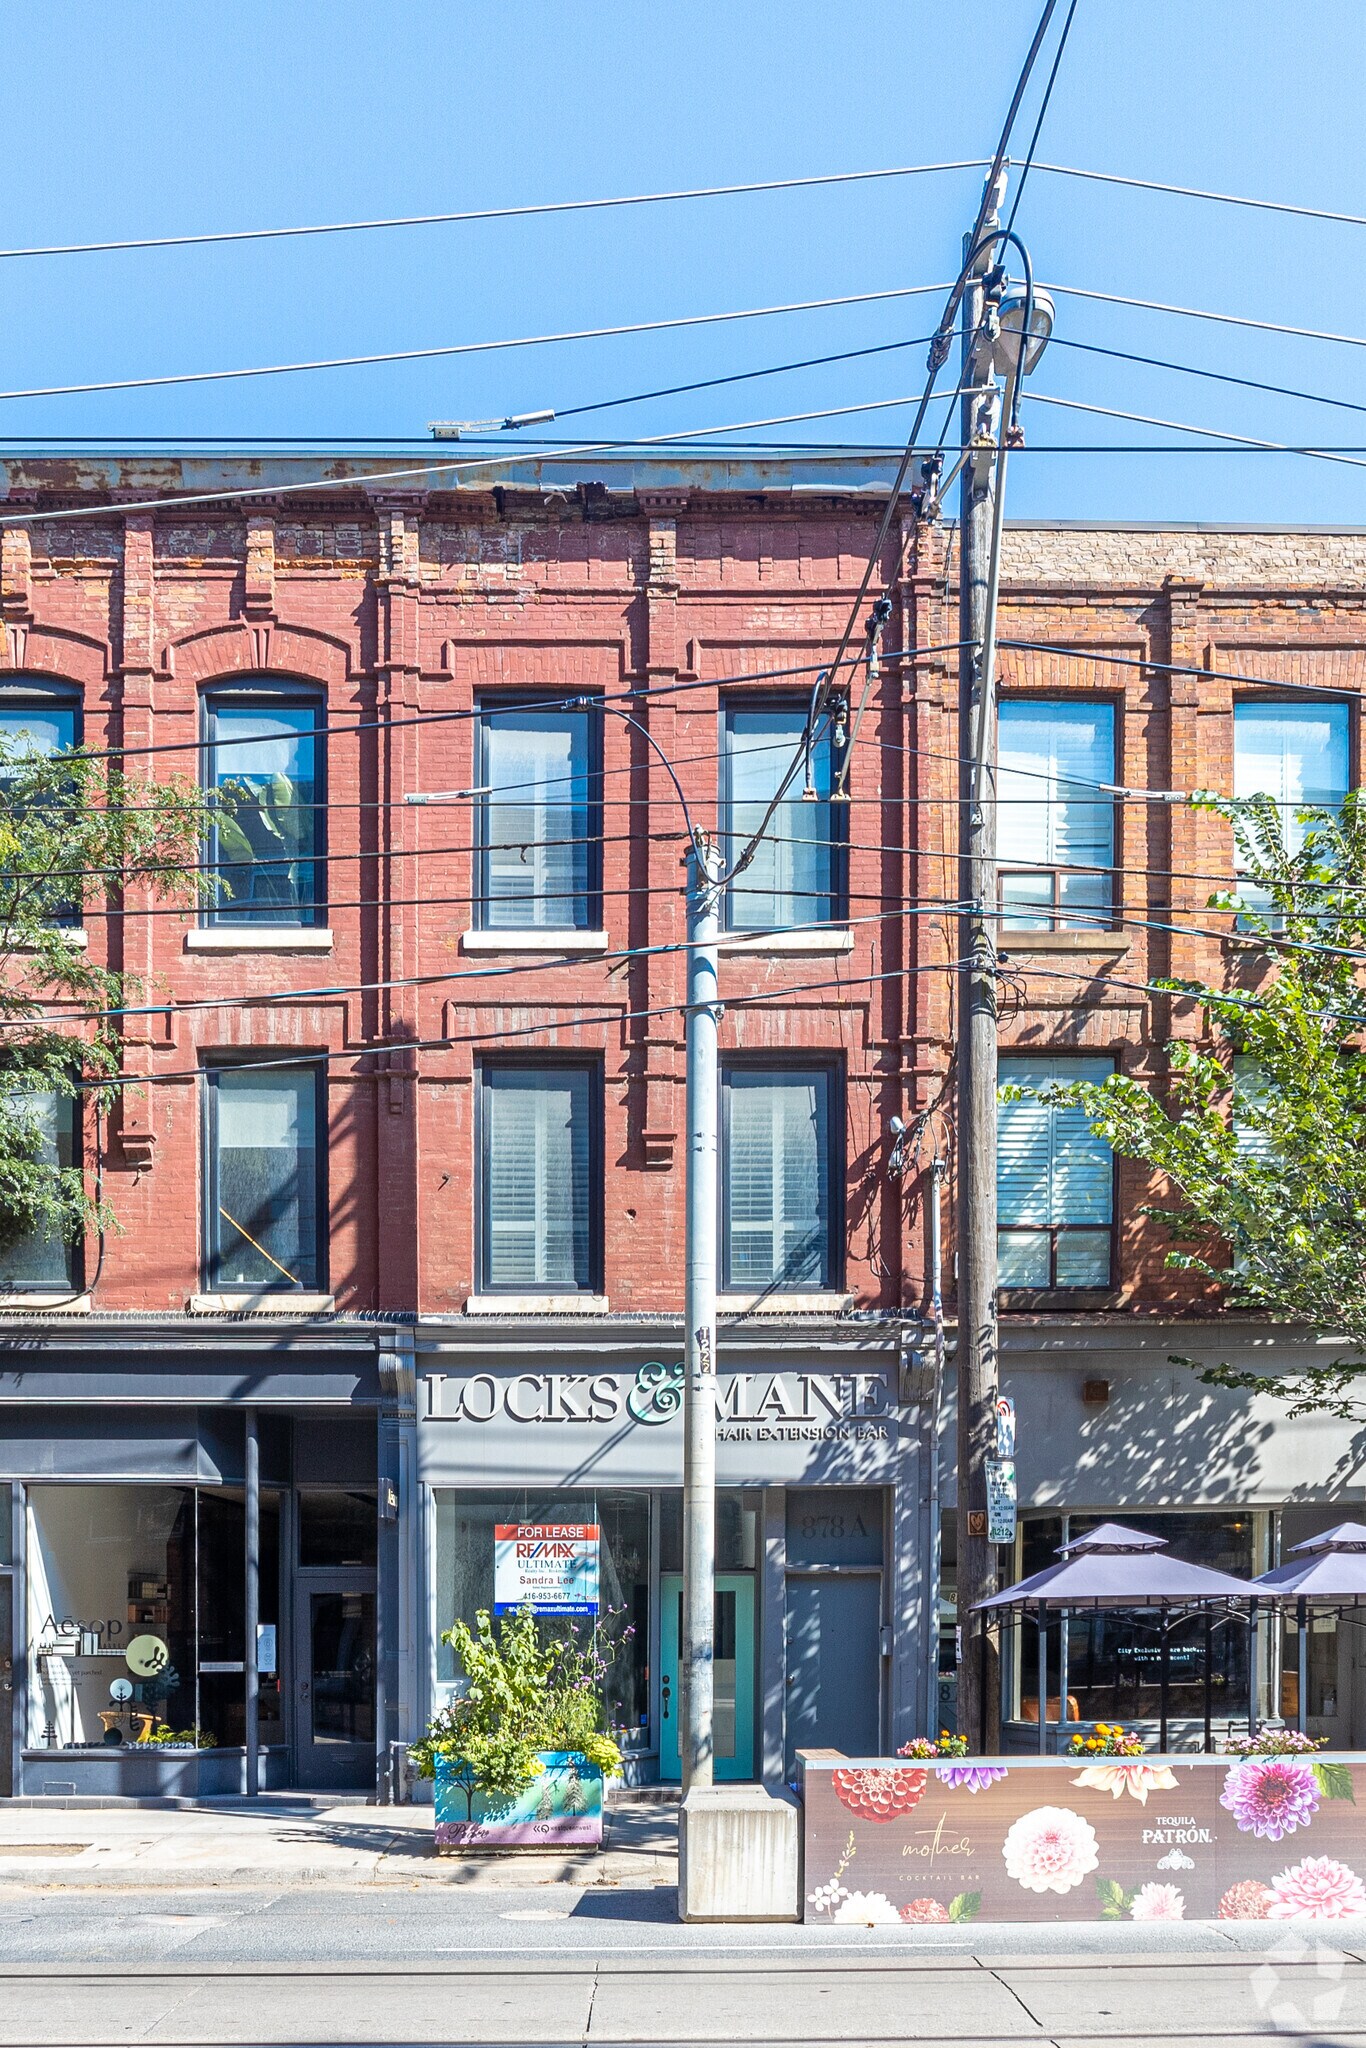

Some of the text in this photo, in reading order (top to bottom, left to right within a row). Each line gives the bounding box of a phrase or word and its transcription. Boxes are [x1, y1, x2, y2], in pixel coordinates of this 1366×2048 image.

[423, 1373, 623, 1422] LOCKS
[715, 1373, 889, 1422] MANE
[715, 1424, 888, 1441] HAIR EXTENSION BAR
[517, 1527, 584, 1538] FOR LEASE
[516, 1541, 576, 1559] RE/MAX
[517, 1559, 577, 1569] ULTIMATE
[519, 1576, 575, 1585] Sandra Lee
[41, 1614, 122, 1641] Aēsop
[1155, 1816, 1197, 1826] TEQUILA
[902, 1812, 976, 1867] mother
